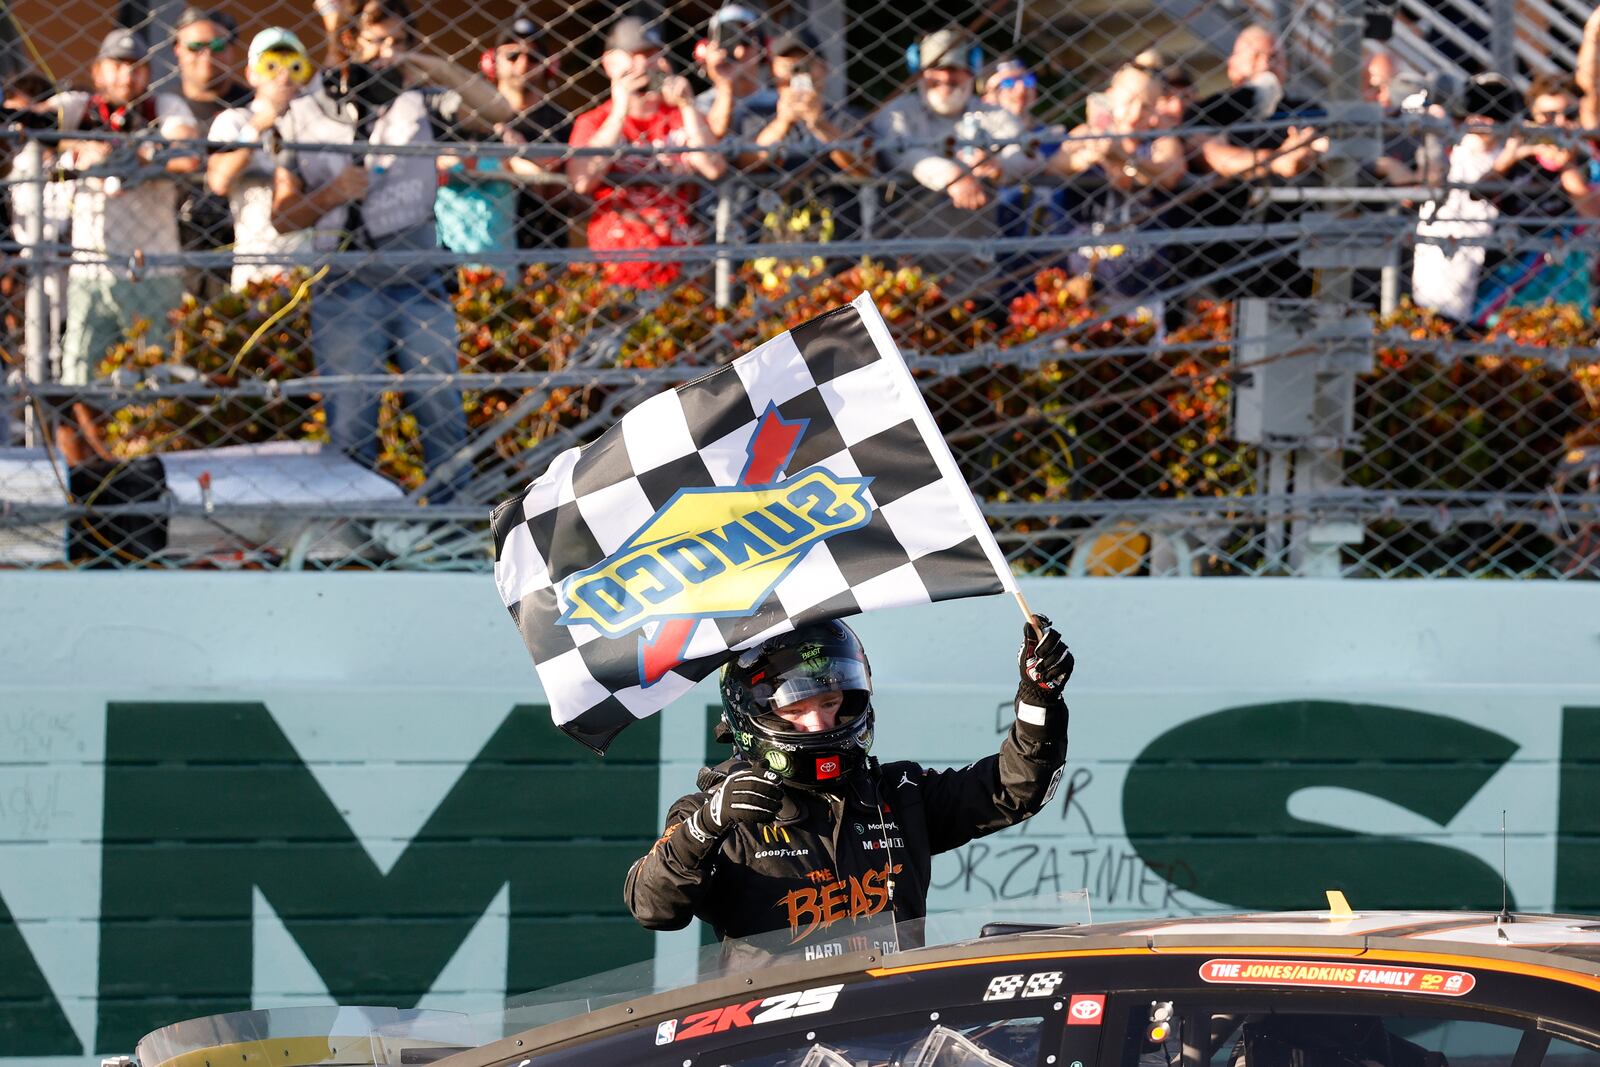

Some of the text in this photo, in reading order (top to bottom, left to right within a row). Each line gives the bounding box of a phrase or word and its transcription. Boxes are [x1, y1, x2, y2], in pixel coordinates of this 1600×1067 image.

[754, 848, 809, 859] GOODYEAR
[805, 868, 835, 884] THE
[930, 842, 1062, 901] ORZA
[774, 862, 903, 944] BEAST
[804, 942, 843, 961] HARD
[1211, 964, 1416, 987] THE JONES/ADKINS FAMILY
[1420, 974, 1444, 986] 50
